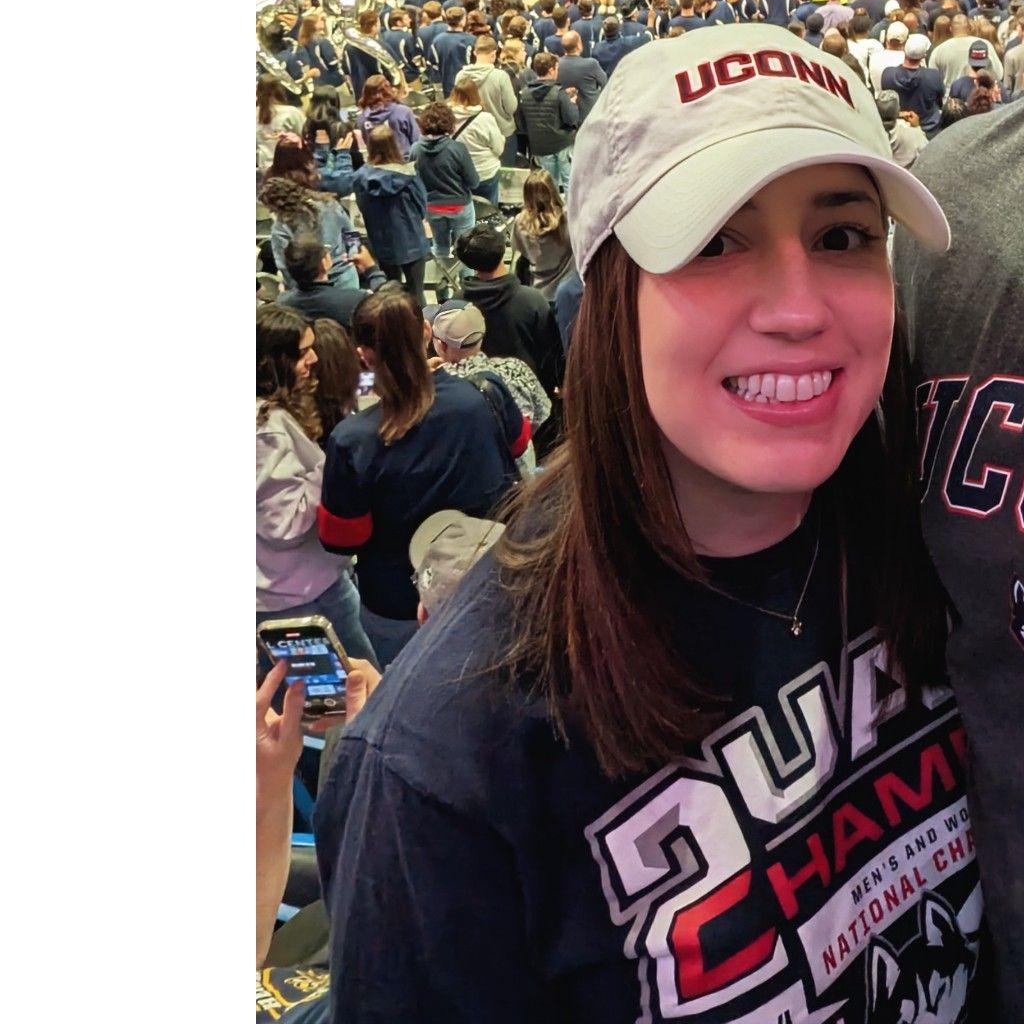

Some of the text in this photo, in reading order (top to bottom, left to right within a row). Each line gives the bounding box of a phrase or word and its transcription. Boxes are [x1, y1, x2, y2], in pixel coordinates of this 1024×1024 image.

[674, 49, 856, 110] UCONN
[851, 855, 899, 906] MEN'S
[904, 827, 939, 860] AND
[820, 866, 928, 976] NATIONAL
